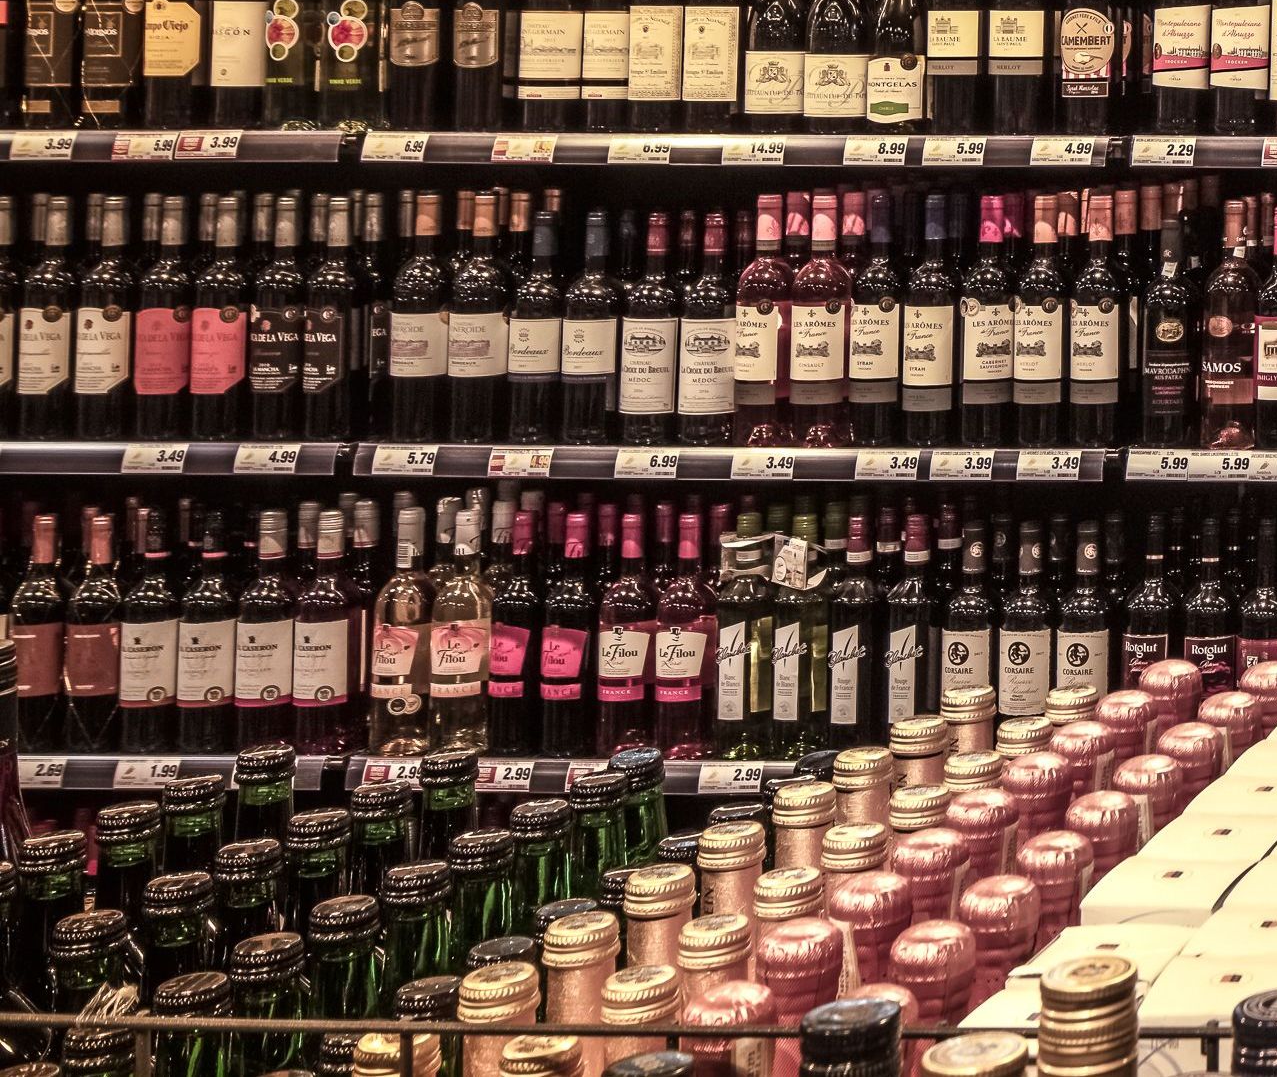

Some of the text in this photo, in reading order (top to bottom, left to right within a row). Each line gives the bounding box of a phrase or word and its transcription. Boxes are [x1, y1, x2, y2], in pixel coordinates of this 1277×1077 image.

[45, 139, 72, 150] 3.99
[210, 138, 238, 149] 3.99
[750, 143, 784, 154] 14.99
[878, 144, 905, 154] 8.99
[957, 144, 983, 154] 5.99
[1064, 144, 1092, 154] 4.99
[1167, 146, 1193, 156] 2.29
[157, 451, 184, 462] 3.49
[269, 452, 296, 463] 4.99
[407, 454, 434, 465] 5.79
[650, 456, 677, 467] 6.99
[766, 457, 794, 469] 3.49
[890, 458, 917, 469] 3.49
[965, 459, 992, 470] 3.99
[1051, 459, 1078, 469] 3.49
[1160, 459, 1188, 470] 5.99
[1222, 459, 1249, 470] 5.99
[602, 648, 610, 657] Le
[151, 766, 177, 778] 1.99
[503, 769, 530, 780] 2.99
[733, 770, 761, 781] 2.99
